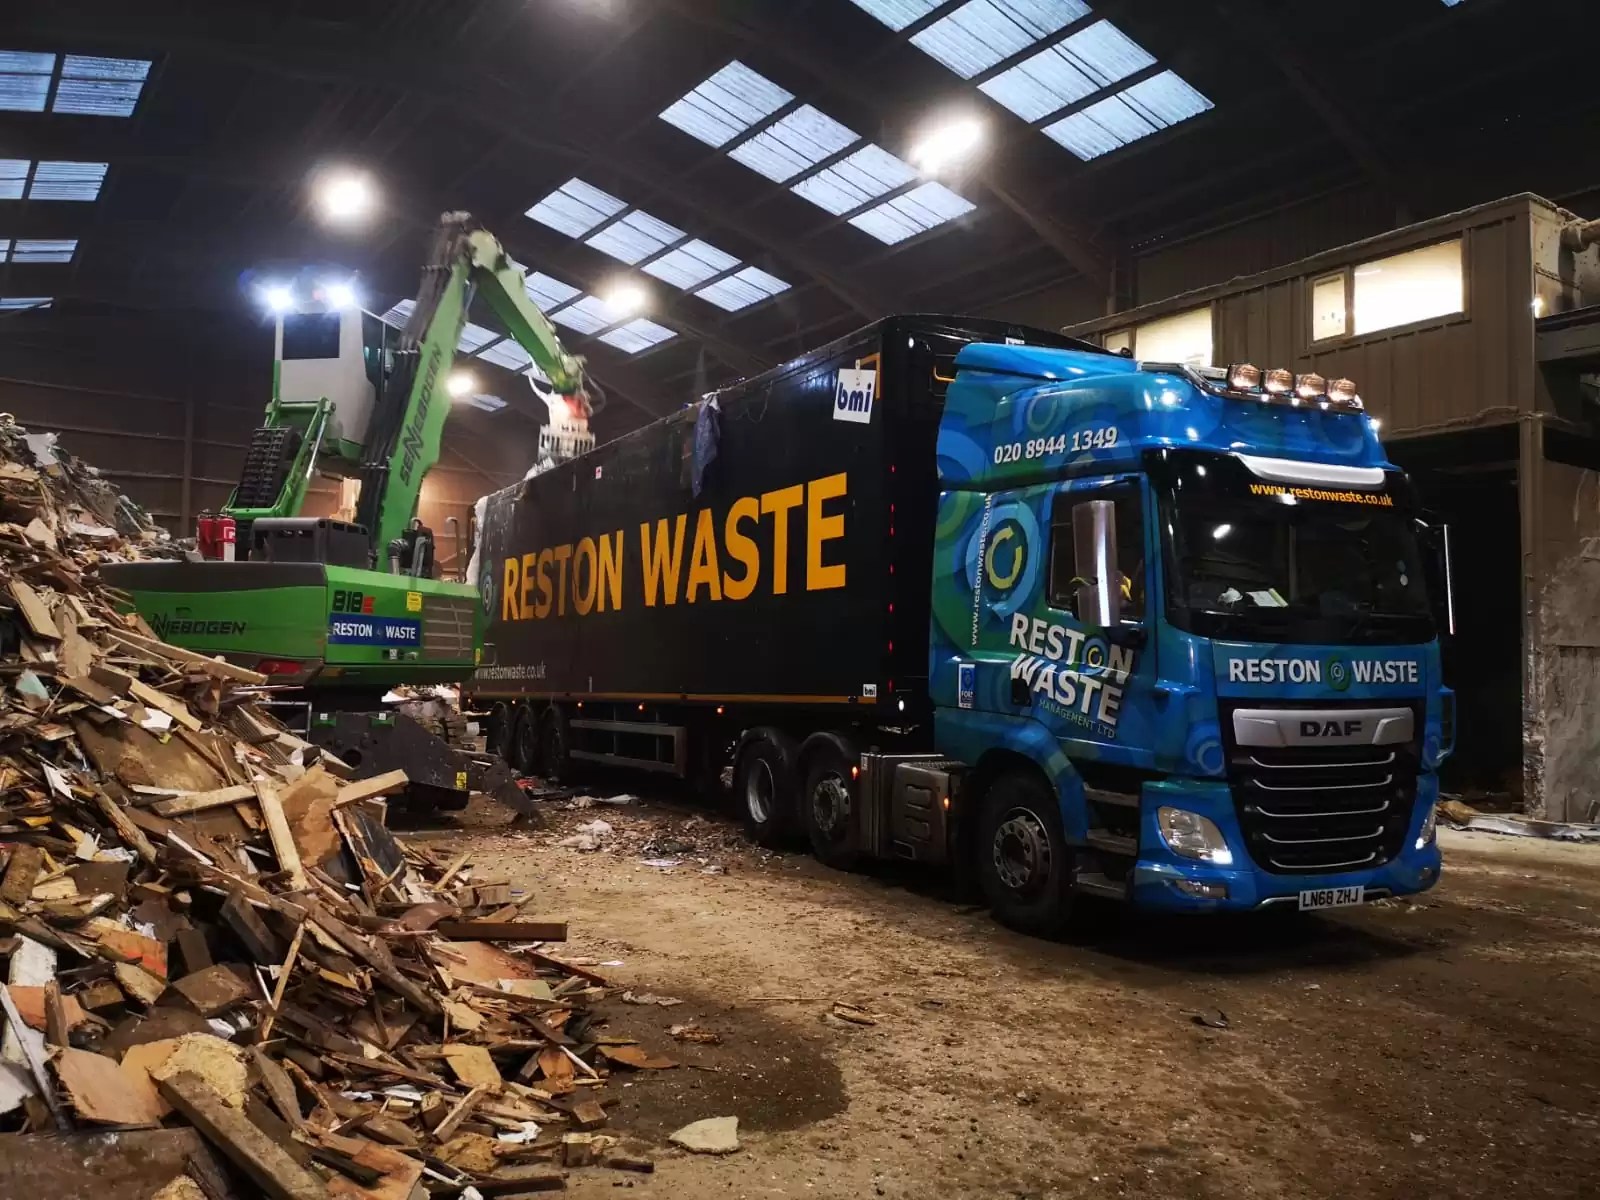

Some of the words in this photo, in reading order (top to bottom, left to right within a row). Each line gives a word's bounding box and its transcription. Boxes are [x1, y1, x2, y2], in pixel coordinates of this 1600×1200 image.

[837, 382, 872, 412] bmi
[994, 443, 1021, 464] 020
[1025, 434, 1066, 459] 8944
[1071, 426, 1118, 452] 1349
[1249, 484, 1393, 506] wwwrestonwaste.co.uk
[502, 530, 624, 621] RESTON
[640, 472, 847, 607] WASTE
[333, 622, 373, 637] RESTON
[385, 625, 416, 640] WASTE
[1009, 612, 1134, 685] RESTON
[1229, 658, 1321, 683] RESTON
[1352, 660, 1418, 683] WASTE
[1010, 652, 1122, 726] WASTE
[1039, 699, 1097, 730] MANAGEMENT
[1097, 723, 1115, 738] LTD
[1300, 720, 1362, 737] DAF
[1302, 890, 1334, 907] LN68
[1336, 888, 1359, 904] ZHJ
